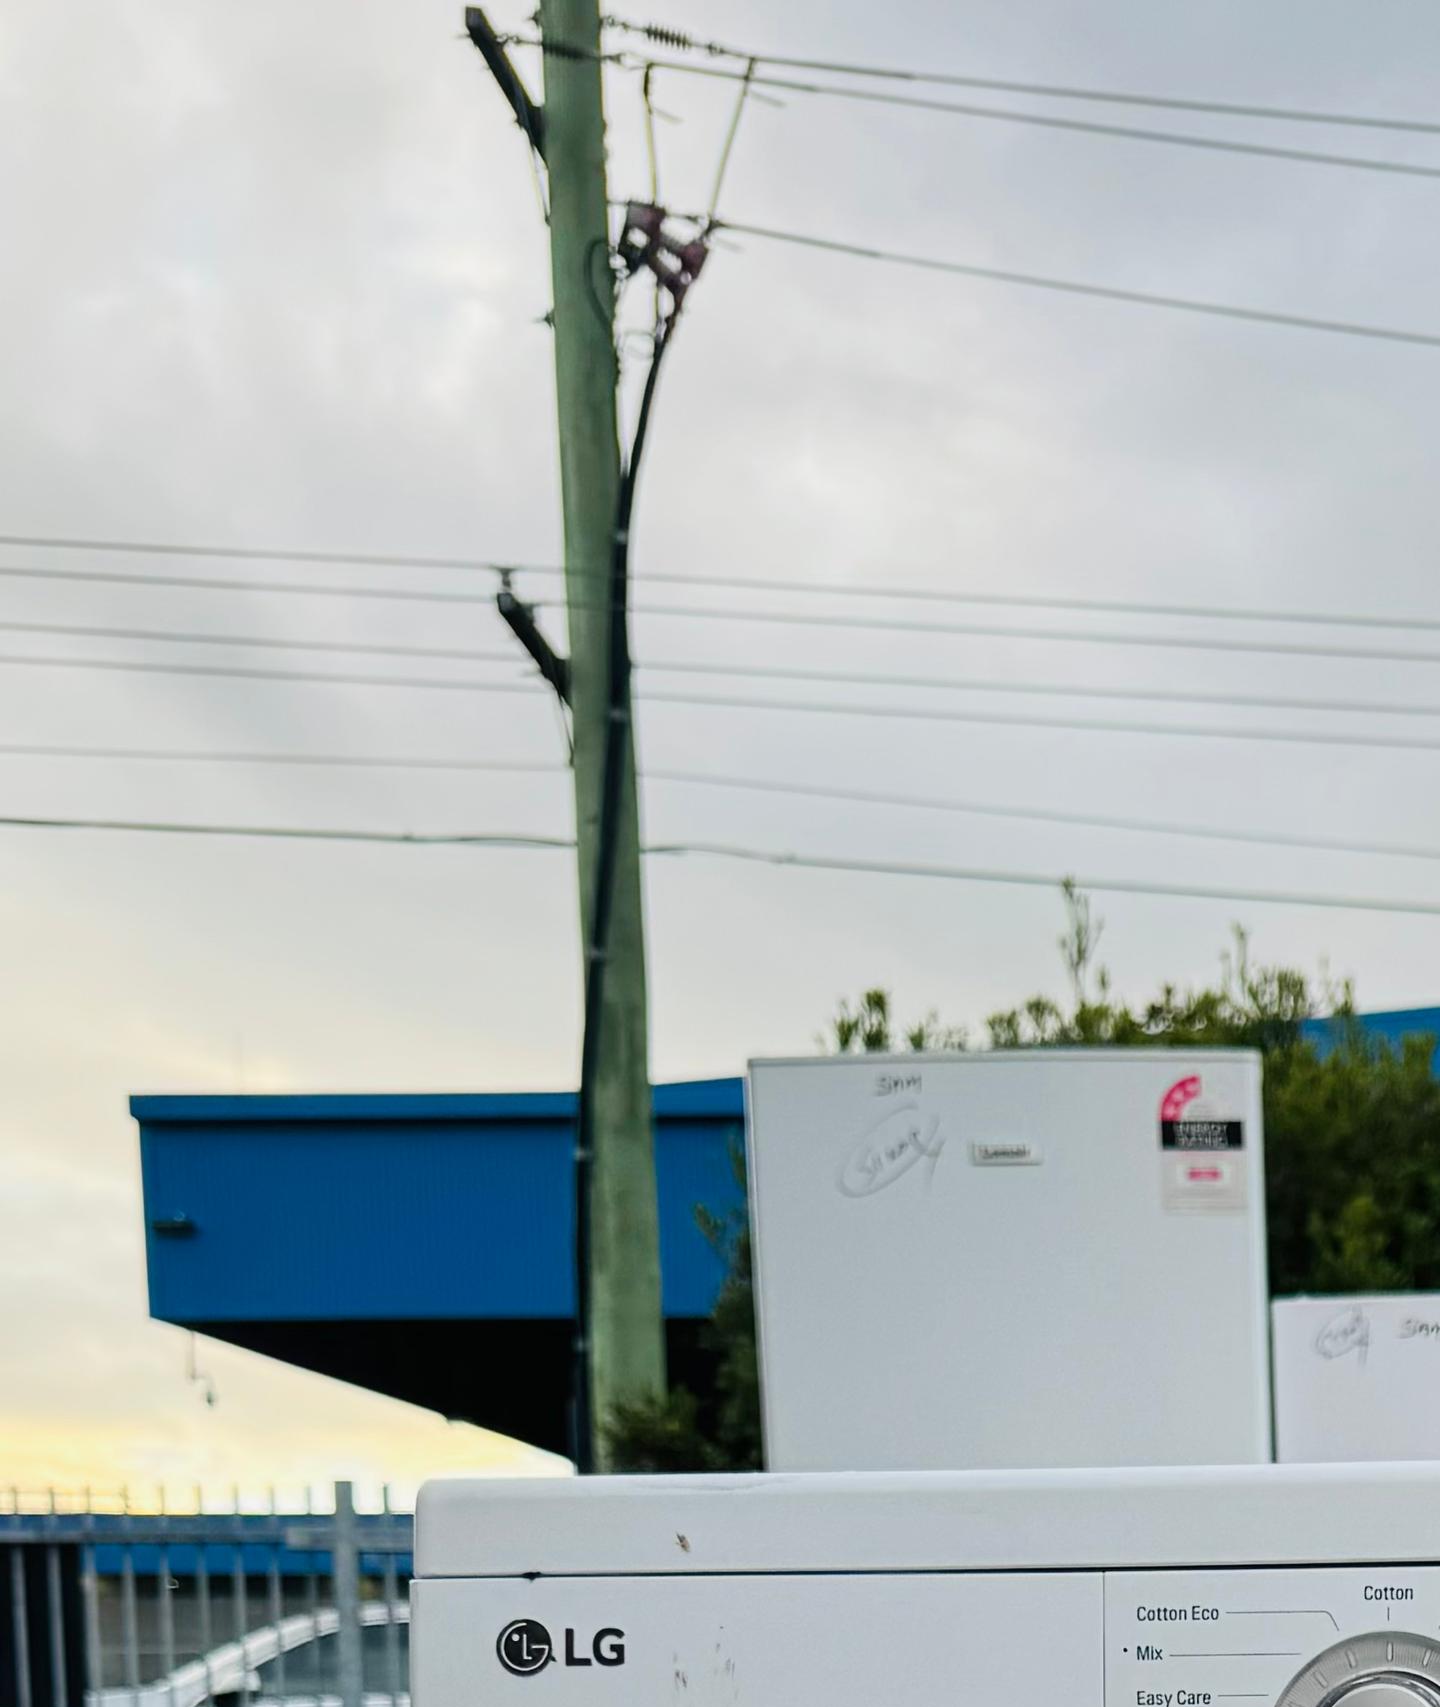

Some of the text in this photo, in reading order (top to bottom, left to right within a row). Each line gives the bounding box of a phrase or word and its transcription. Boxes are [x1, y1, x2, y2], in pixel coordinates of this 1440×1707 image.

[1363, 1585, 1414, 1602] Cotton
[1136, 1604, 1220, 1622] Cotton Eco
[565, 1627, 626, 1667] LG
[1136, 1644, 1164, 1661] Mix
[1176, 1689, 1212, 1706] Care
